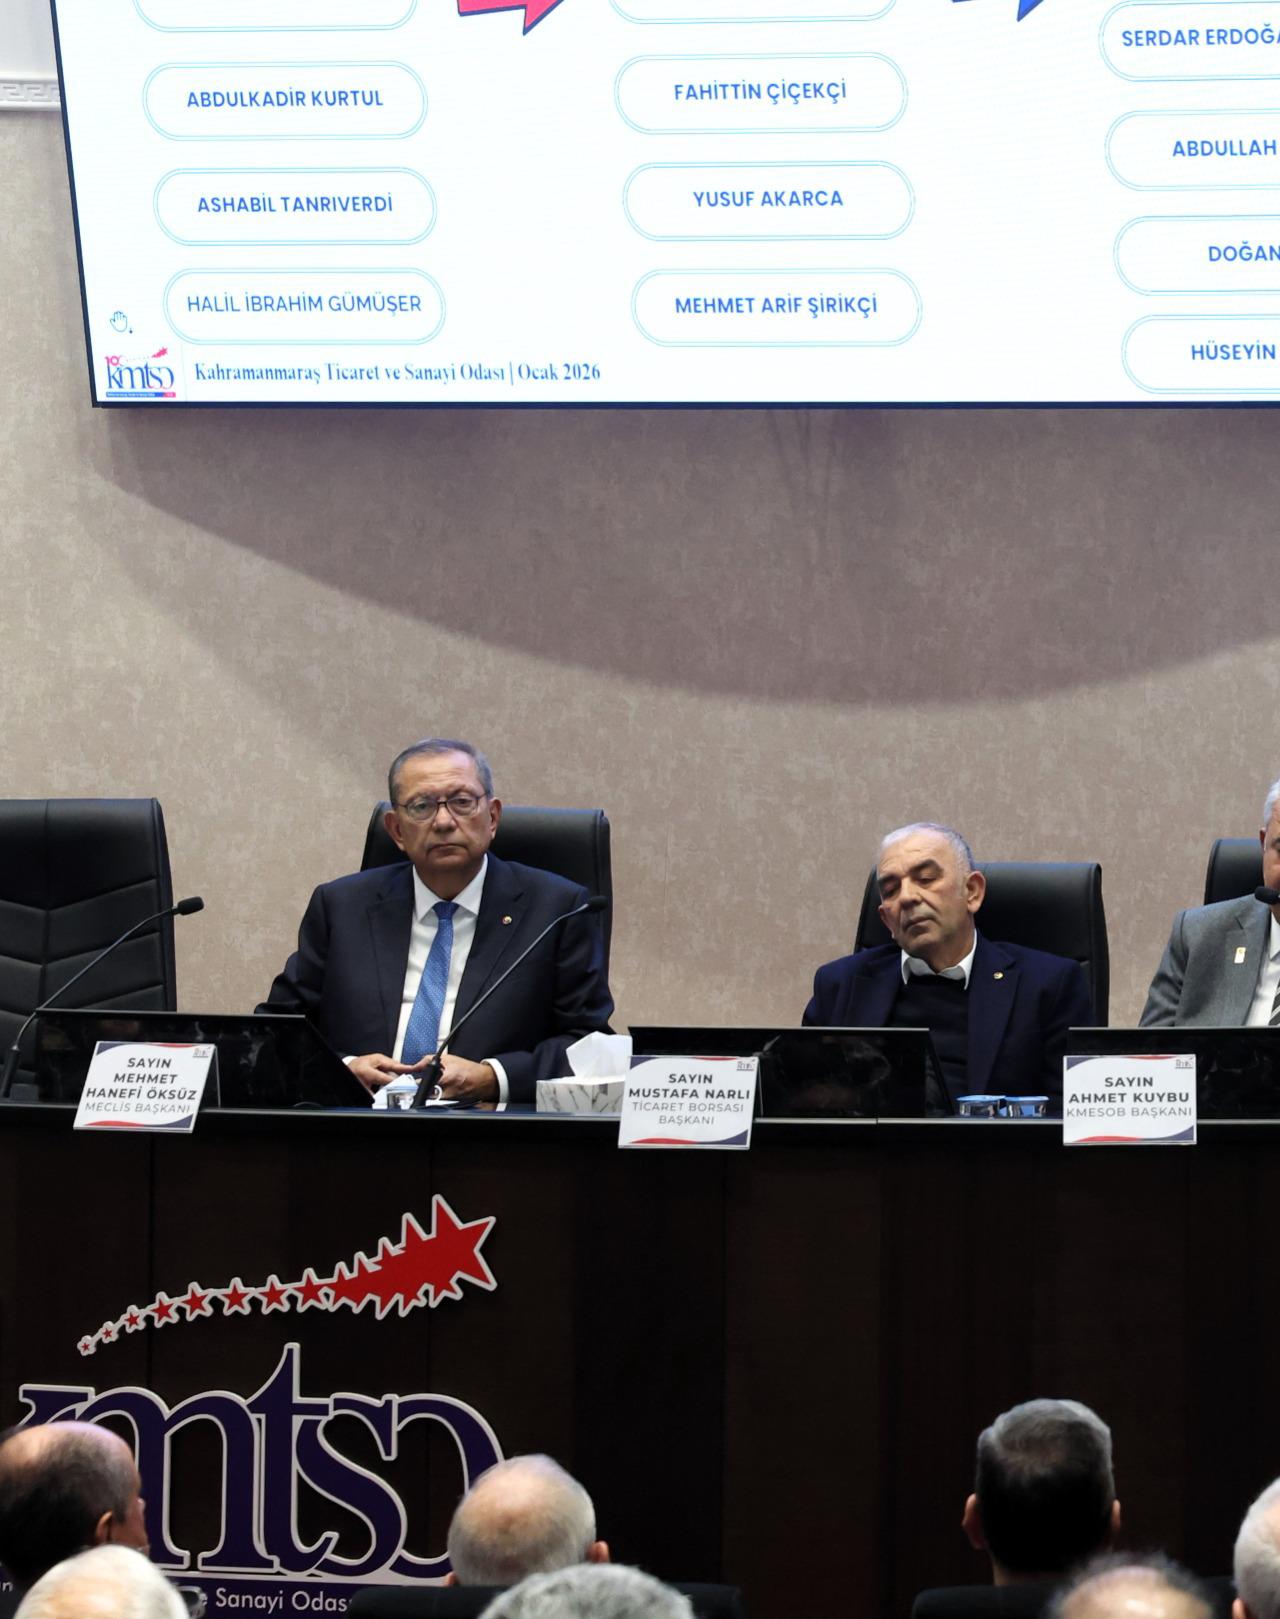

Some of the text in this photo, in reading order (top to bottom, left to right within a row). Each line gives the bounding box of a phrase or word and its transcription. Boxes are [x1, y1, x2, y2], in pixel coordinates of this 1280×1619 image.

[1121, 29, 1200, 47] SERDAR
[187, 86, 384, 108] ABDULKADİR KURTUL
[674, 79, 846, 105] FAHİTTİN ÇİÇEKÇİ
[1172, 139, 1277, 157] ABDULLAH
[198, 192, 393, 213] ASHABİL TANRIVERDİ
[693, 190, 844, 208] YUSUF AKARCA
[187, 291, 421, 316] HALİL İBRAHİM GÜMÜŞER
[675, 293, 877, 319] MEHMET ARİF ŞİRİKÇİ
[1191, 340, 1276, 361] HÜSEYİN
[195, 363, 321, 384] Kahramanmaraş
[325, 363, 380, 381] Ticaret
[384, 367, 400, 381] ve
[404, 363, 456, 384] Sanayi
[460, 363, 505, 381] Odası
[517, 363, 558, 381] Ocak
[563, 363, 601, 381] 2026
[127, 1057, 172, 1069] SAYIN
[113, 1073, 178, 1085] MEHMET
[668, 1073, 714, 1084] SAYIN
[1104, 1077, 1154, 1088] SAYIN
[85, 1085, 198, 1101] HANEFİ ÖKSÜZ
[628, 1088, 750, 1100] MUSTAFA NARLI
[1068, 1092, 1190, 1104] AHMET KUYBU
[84, 1101, 191, 1115] MECLİS BAŞKANI
[632, 1100, 744, 1112] TİCARET BORSASI
[1066, 1107, 1192, 1119] KMESOB BAŞKANI
[658, 1115, 715, 1127] BAŞKANI
[215, 1587, 284, 1615] Sanayi
[291, 1590, 353, 1613] Odas
